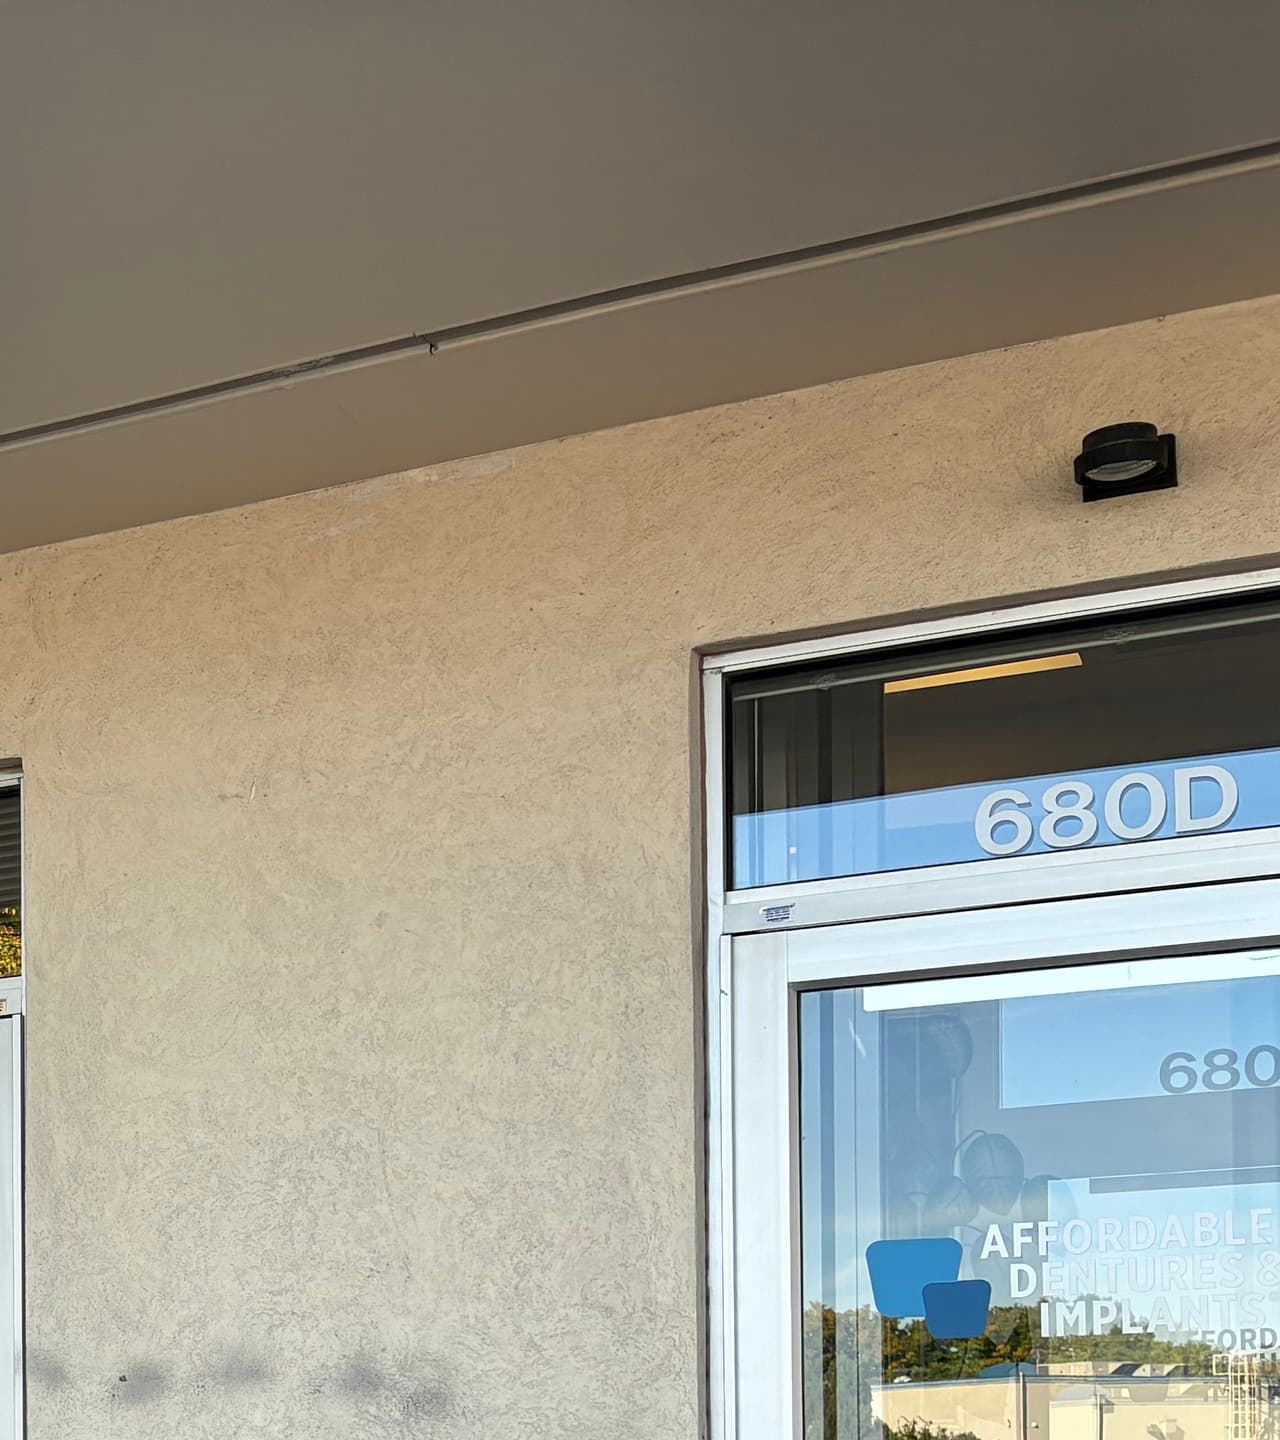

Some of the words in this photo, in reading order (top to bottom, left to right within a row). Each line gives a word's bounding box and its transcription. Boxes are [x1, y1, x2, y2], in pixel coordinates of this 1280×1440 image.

[974, 764, 1240, 856] 680D
[979, 1206, 1274, 1261] AFFORDABLE
[1009, 1251, 1246, 1299] DENTURES
[1256, 1249, 1280, 1288] &
[1039, 1292, 1267, 1339] IMPLANTS
